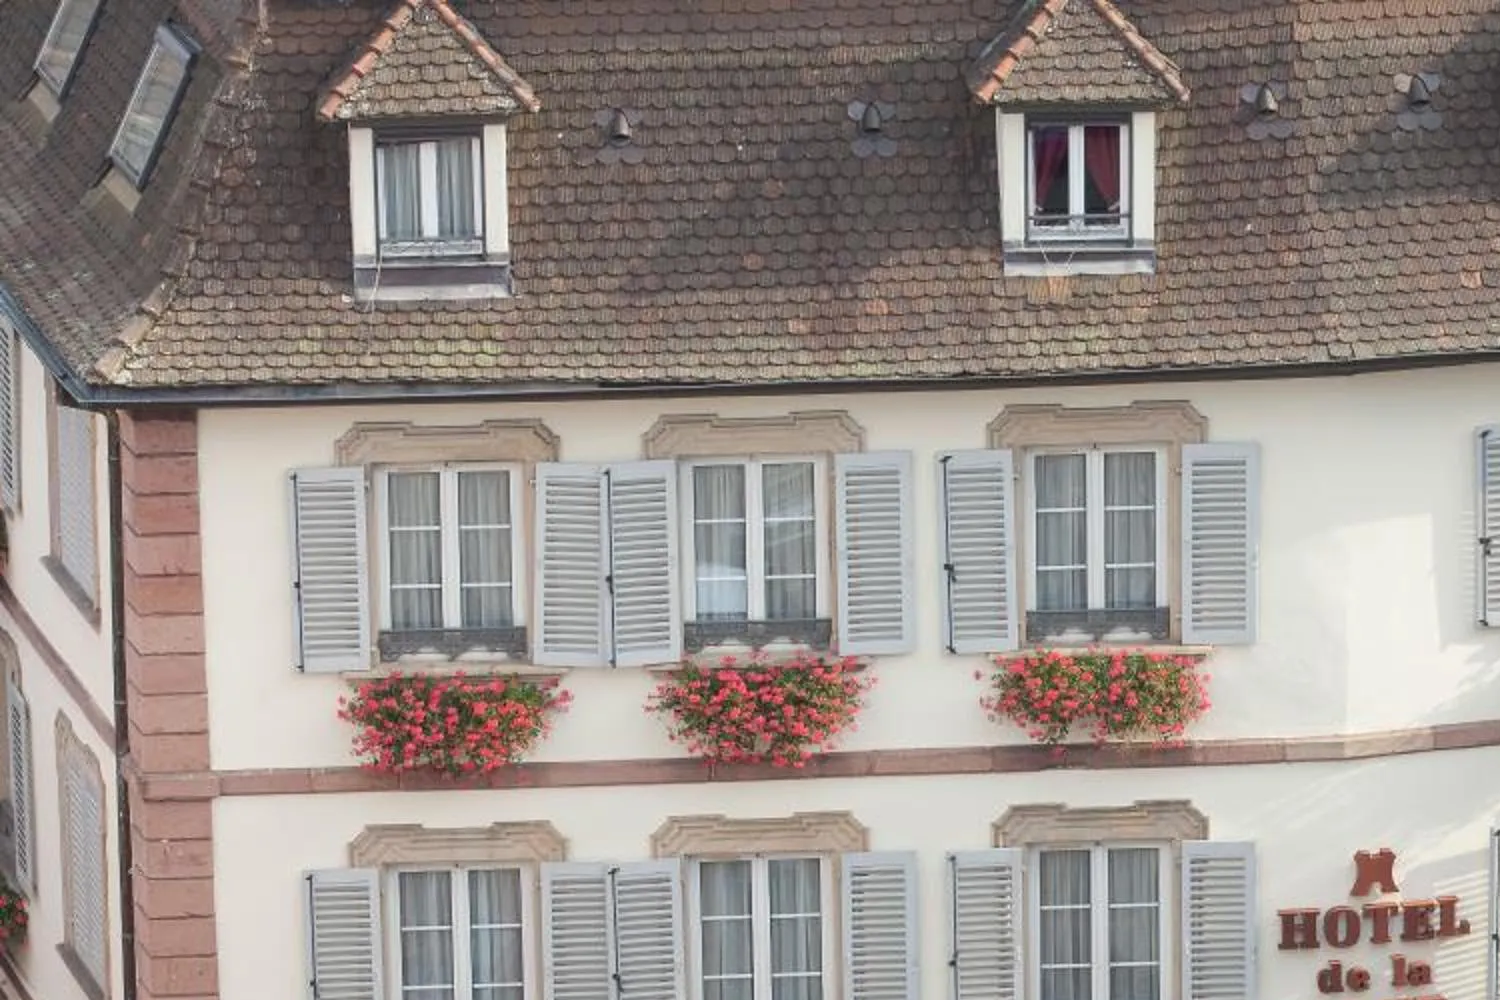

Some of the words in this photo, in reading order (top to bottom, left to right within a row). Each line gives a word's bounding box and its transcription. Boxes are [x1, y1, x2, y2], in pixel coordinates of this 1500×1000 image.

[1277, 895, 1471, 950] HOTEL
[1317, 959, 1371, 994] de
[1391, 953, 1433, 987] la
